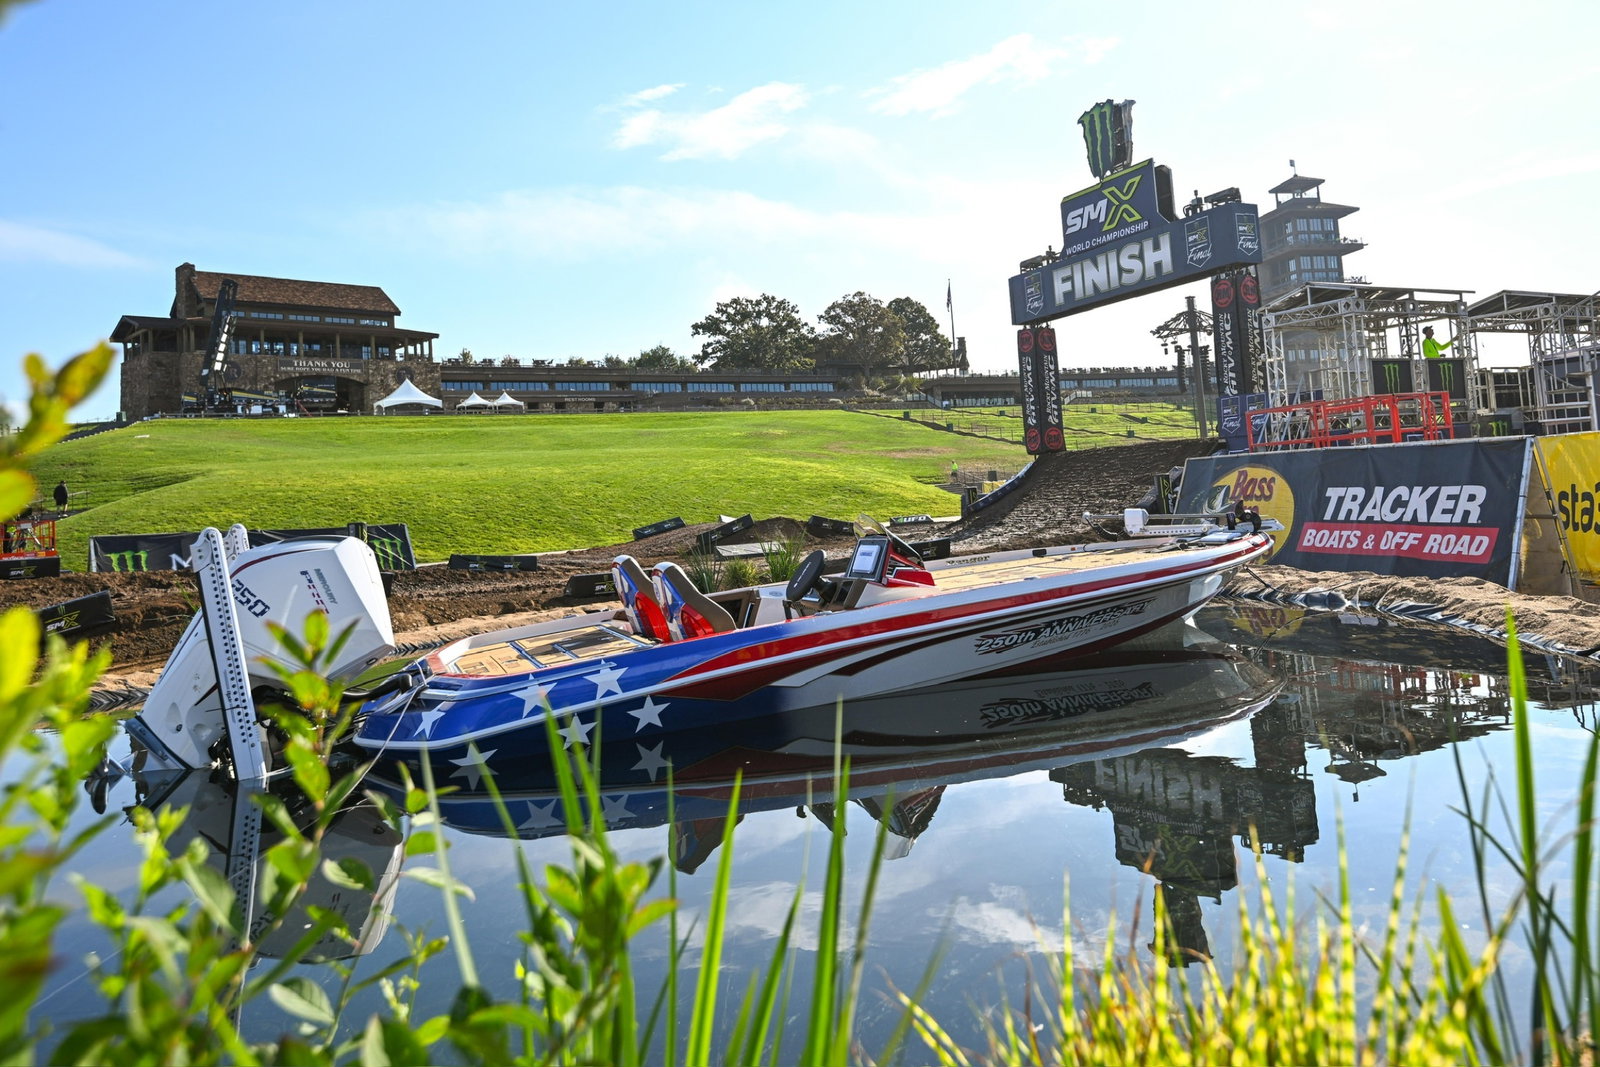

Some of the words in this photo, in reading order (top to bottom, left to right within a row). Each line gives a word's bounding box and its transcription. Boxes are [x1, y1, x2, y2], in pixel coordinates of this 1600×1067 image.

[1065, 174, 1142, 235] SMX
[1066, 240, 1091, 256] WORLD
[1091, 221, 1149, 247] CHAMPIONSHIP
[1238, 236, 1259, 250] Final
[1187, 243, 1212, 264] Final
[1053, 231, 1174, 307] FINISH
[1218, 313, 1227, 357] MOUNTAIN
[1246, 308, 1255, 354] MOUNTAIN
[293, 360, 328, 368] THANK
[331, 361, 351, 369] YOU
[1221, 358, 1229, 384] ROCKY
[1250, 355, 1258, 383] ROCKY
[1222, 416, 1242, 429] Final
[1229, 469, 1276, 502] Bass
[1322, 484, 1487, 524] TRACKER
[903, 515, 927, 523] UFO
[1302, 528, 1361, 549] BOATS
[1363, 533, 1375, 550] &
[1380, 530, 1423, 551] OFF
[1423, 533, 1490, 556] ROAD
[46, 614, 80, 632] SMX
[977, 628, 1035, 652] 250th
[1037, 602, 1152, 639] ANNIVERSARY
